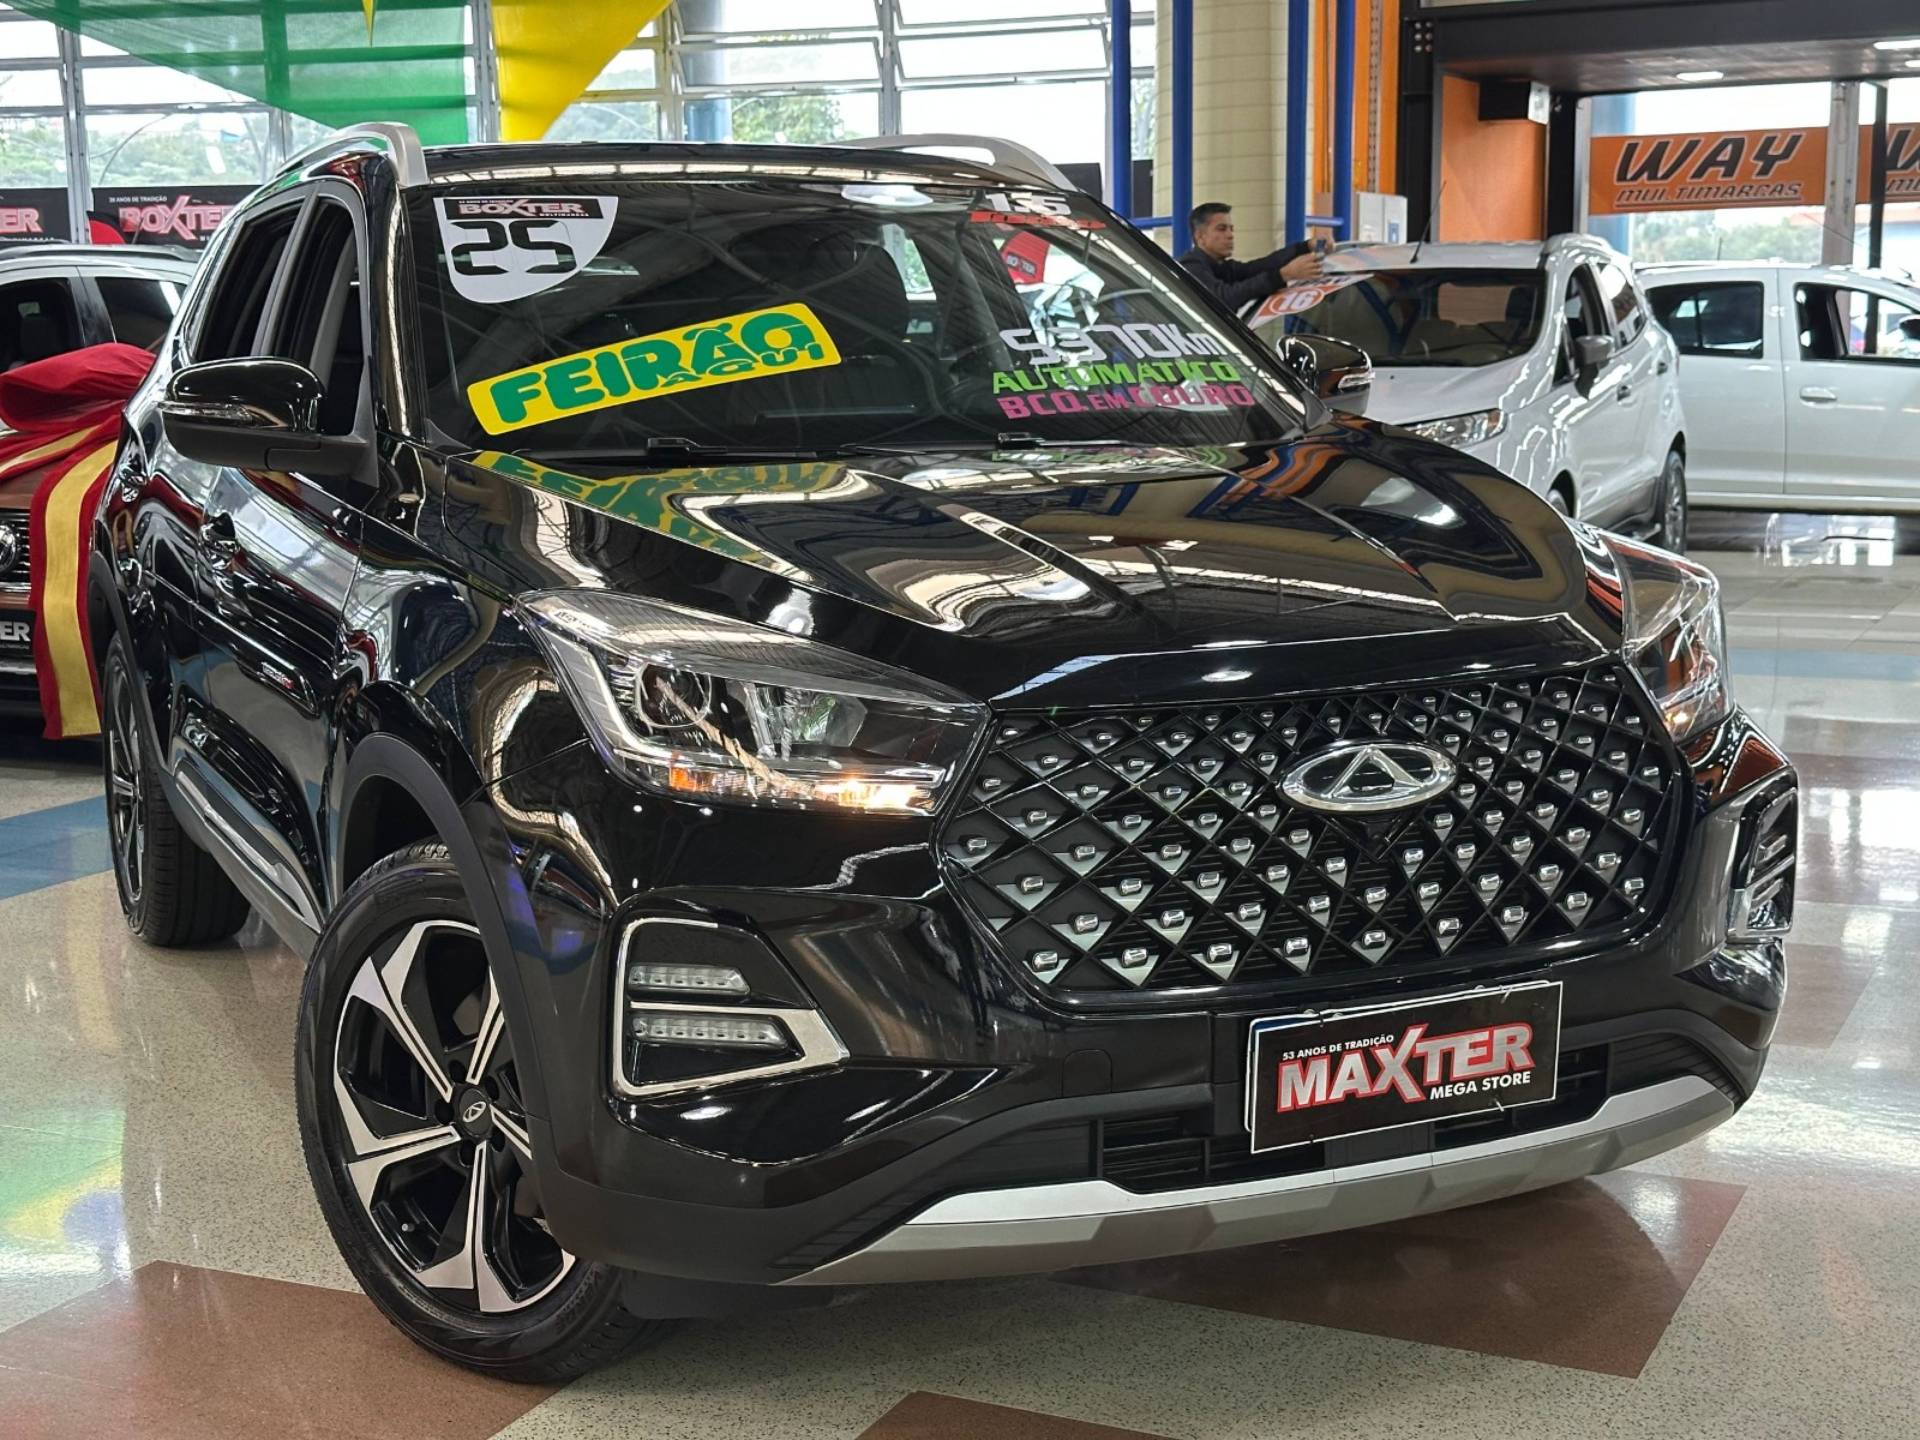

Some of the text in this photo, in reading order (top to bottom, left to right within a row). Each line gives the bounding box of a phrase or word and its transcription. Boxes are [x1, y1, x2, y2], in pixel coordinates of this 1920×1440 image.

[1615, 132, 1804, 184] WAY
[459, 199, 585, 217] BOXTER
[450, 219, 578, 277] 25
[489, 311, 817, 425] FEIRÃO
[659, 341, 825, 389] AQUI
[1277, 1022, 1536, 1114] MAXTER
[1282, 1033, 1395, 1062] 53 ANOS DE TRADIÇÃO
[1430, 1070, 1532, 1101] MEGA STORE
